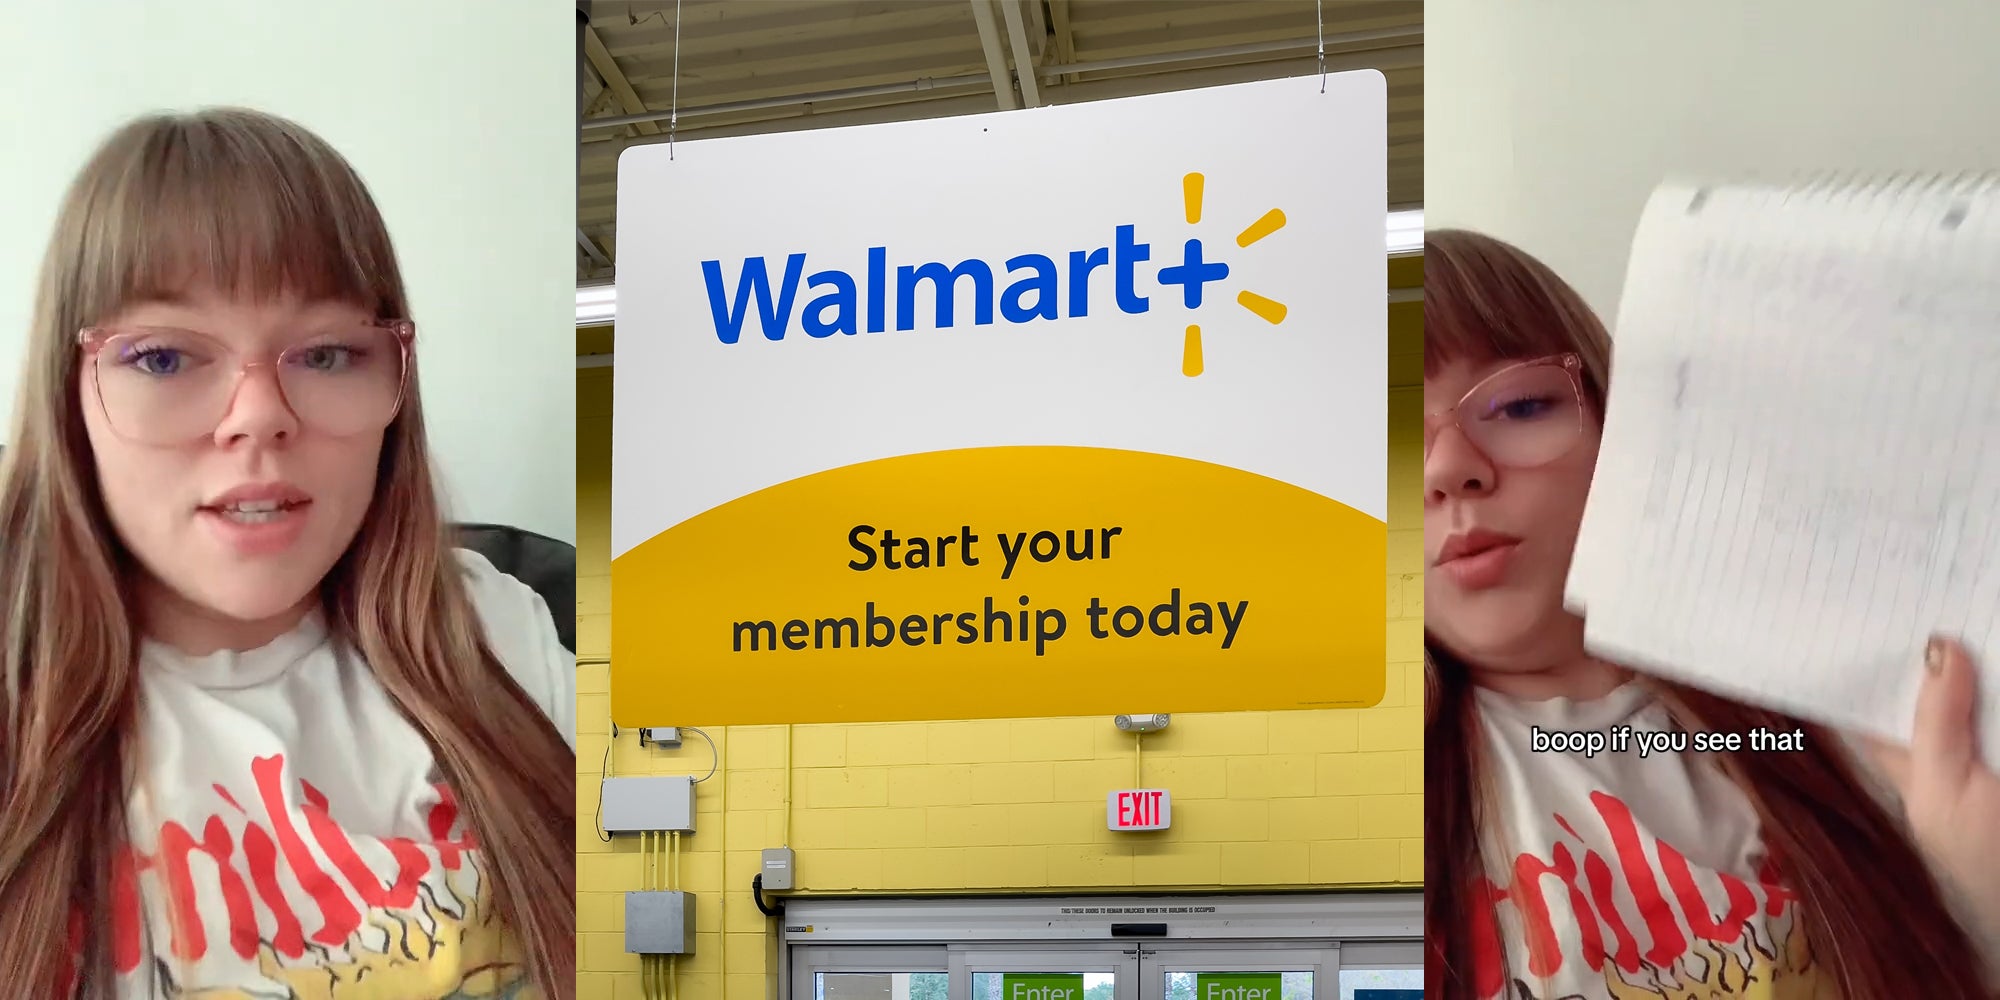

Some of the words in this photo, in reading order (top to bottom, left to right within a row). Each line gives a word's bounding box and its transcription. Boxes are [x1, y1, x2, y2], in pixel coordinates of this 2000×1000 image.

[847, 524, 980, 572] Start
[996, 526, 1123, 580] your
[732, 594, 1067, 657] membership
[1086, 587, 1249, 650] today
[1117, 791, 1163, 827] EXIT
[1013, 983, 1075, 1000] Enter
[1207, 983, 1272, 1000] Enter
